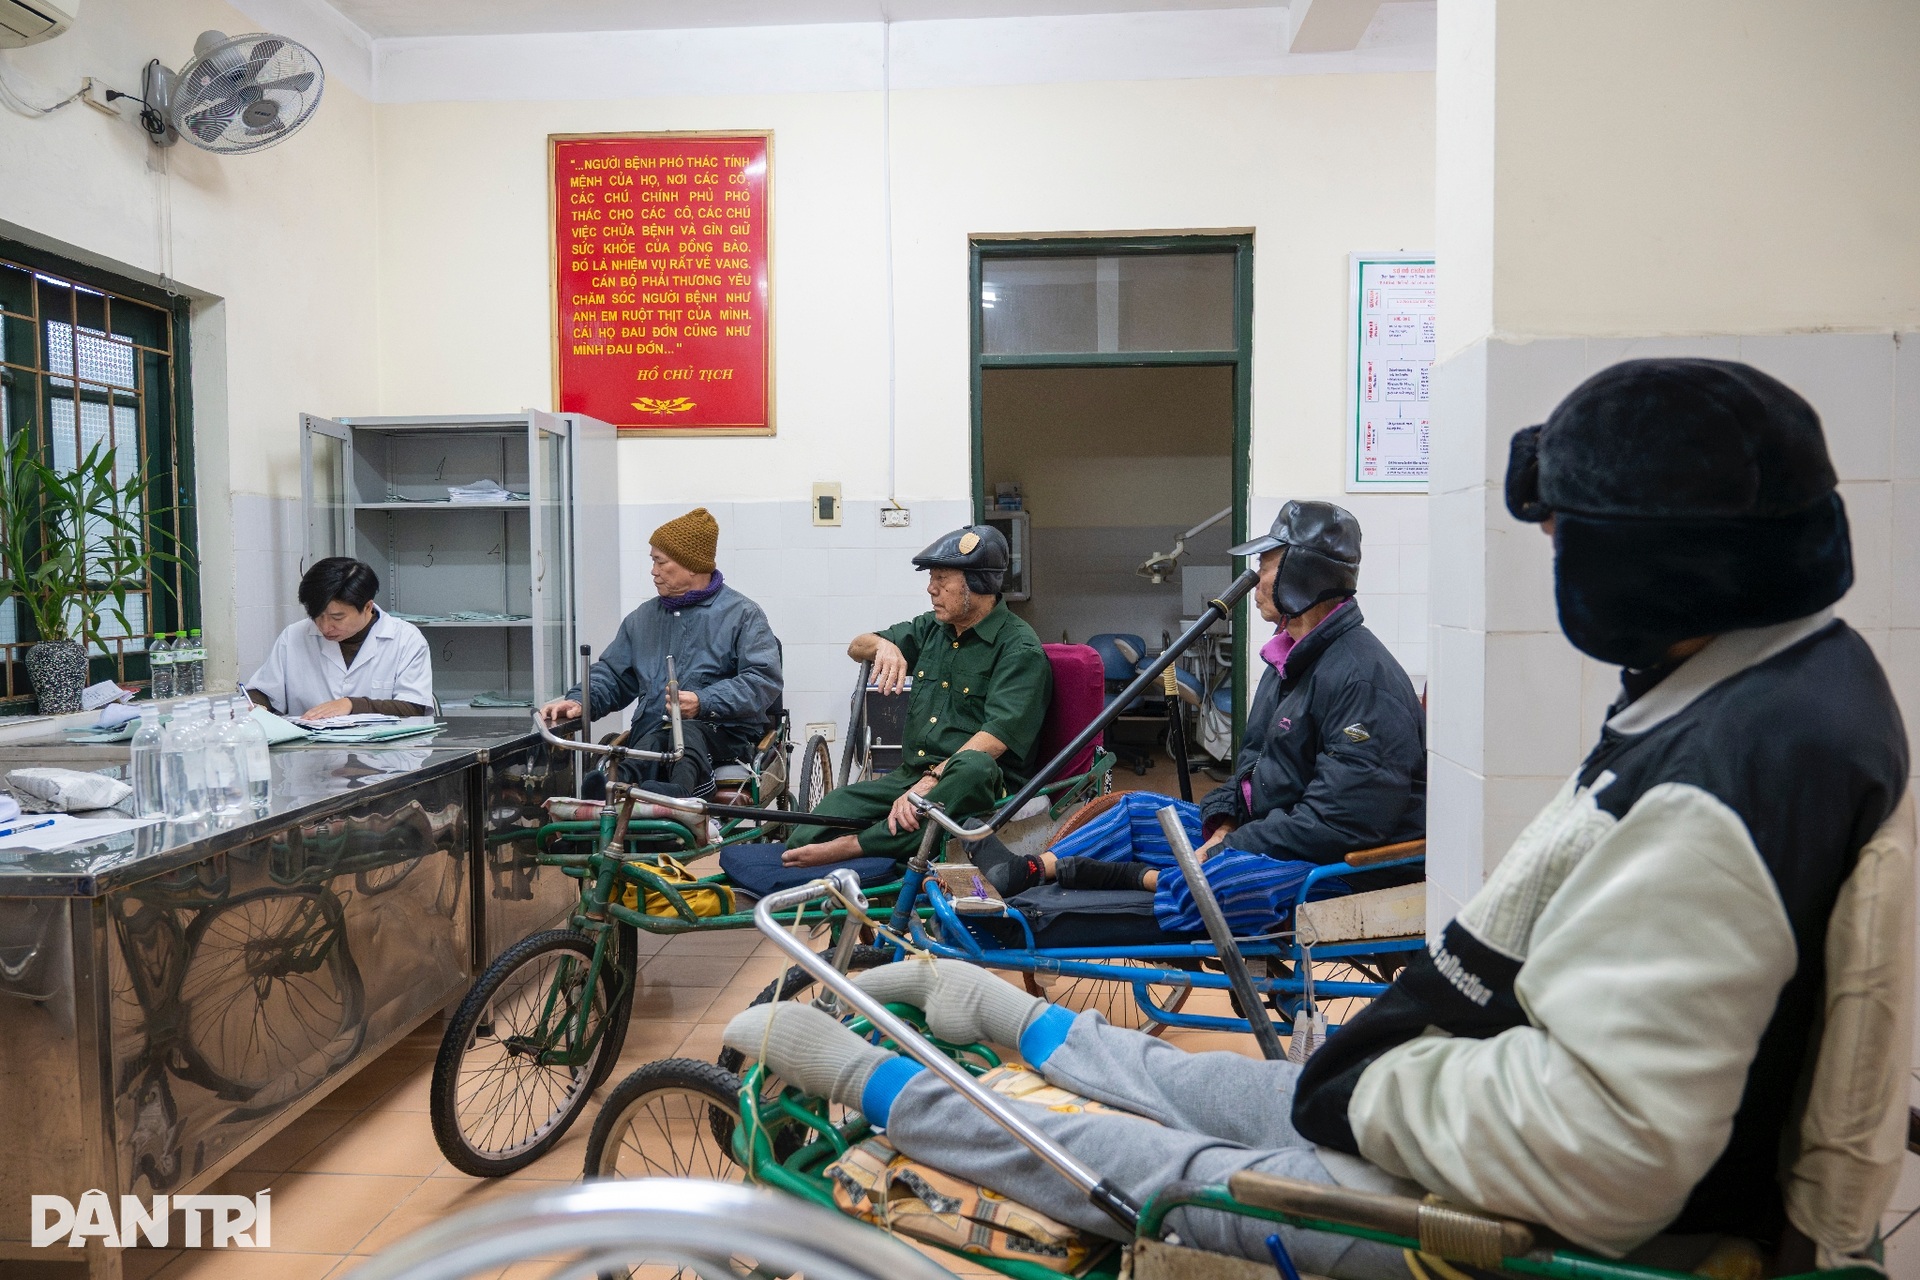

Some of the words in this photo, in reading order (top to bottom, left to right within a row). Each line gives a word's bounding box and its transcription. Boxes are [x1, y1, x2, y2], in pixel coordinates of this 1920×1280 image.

[625, 156, 656, 169] BỆNH
[660, 156, 684, 168] PHÓ
[687, 154, 718, 168] THÁC
[724, 154, 750, 167] TÍNH
[570, 175, 602, 188] MỆNH
[609, 172, 633, 186] CỦA
[640, 175, 660, 187] HỌ,
[667, 174, 686, 185] NƠI
[694, 172, 719, 184] CÁC
[570, 191, 594, 204] CÁC
[642, 190, 679, 202] CHÍNH
[725, 188, 750, 201] PHÓ
[571, 208, 601, 221] THÁC
[609, 209, 634, 220] CHO
[641, 206, 665, 219] CÁC
[697, 206, 723, 218] CÁC
[726, 207, 751, 218] CHÚ
[572, 225, 597, 240] VIỆC
[602, 224, 635, 237] CHỮA
[642, 223, 674, 238] BỆNH
[680, 223, 696, 236] VÀ
[703, 223, 722, 235] GÌN
[730, 221, 751, 235] GIỮ
[571, 240, 594, 255] SỨC
[604, 239, 636, 254] KHỎE
[645, 238, 670, 253] CỦA
[679, 238, 713, 252] ĐỒNG
[572, 256, 588, 272] ĐÓ
[592, 256, 608, 271] LÀ
[611, 258, 647, 273] NHIỆM
[651, 258, 666, 274] VỤ
[670, 255, 693, 269] RẤT
[695, 255, 711, 269] VẺ
[592, 274, 616, 288] CÁN
[620, 274, 637, 290] BỘ
[642, 271, 669, 287] PHẢI
[672, 275, 722, 287] THƯƠNG
[729, 272, 751, 286] YÊU
[572, 293, 605, 306] CHĂM
[611, 291, 635, 305] SÓC
[642, 290, 679, 304] NGƯỜI
[685, 290, 717, 304] BỆNH
[726, 292, 751, 303] NHƯ
[573, 311, 597, 322] ANH
[601, 311, 617, 321] EM
[622, 307, 654, 323] RUỘT
[657, 310, 683, 322] THỊT
[687, 306, 712, 321] CỦA
[599, 326, 615, 340] HỌ
[621, 327, 646, 338] ĐAU
[652, 324, 678, 337] ĐỚN
[684, 323, 717, 337] CŨNG
[726, 325, 751, 337] NHƯ
[573, 342, 603, 356] MÌNH
[606, 344, 633, 355] ĐAU
[636, 365, 659, 381] HỒ
[663, 365, 694, 381] CHỦ
[699, 368, 733, 383] TỊCH
[434, 456, 447, 481] 1
[422, 544, 434, 568] 3
[442, 639, 454, 662] 6
